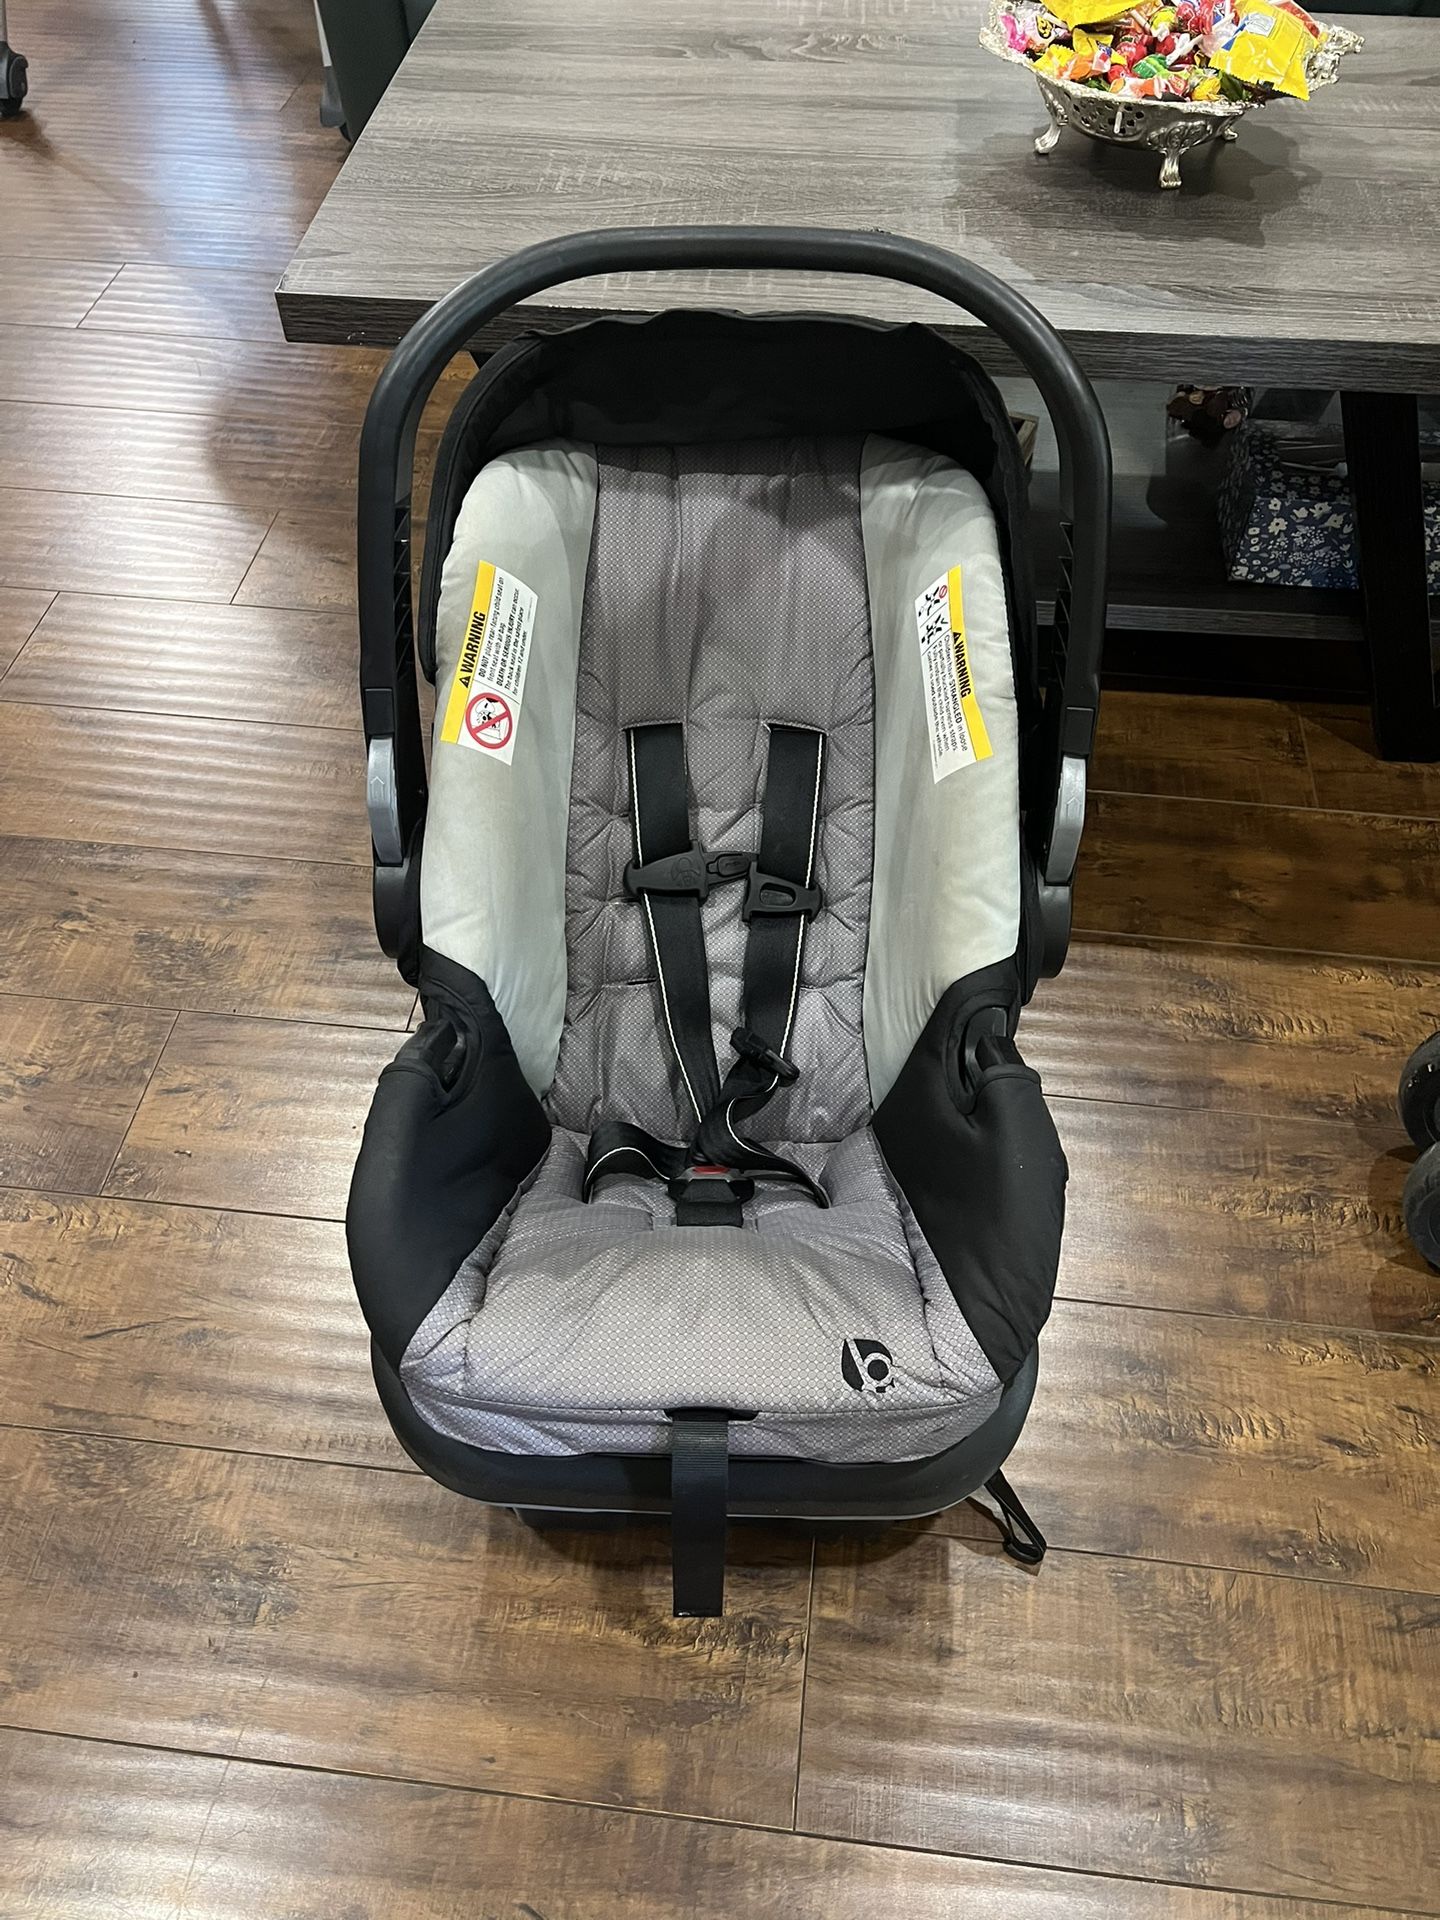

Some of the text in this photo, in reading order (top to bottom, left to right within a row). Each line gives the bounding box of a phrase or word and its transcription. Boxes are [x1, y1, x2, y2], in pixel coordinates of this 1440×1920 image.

[461, 611, 486, 673] WARNING
[481, 656, 489, 668] NOT
[497, 667, 506, 686] DEATH
[503, 635, 512, 658] SERIOUS
[944, 635, 952, 662] Children
[950, 679, 963, 723] STRANGLED
[955, 641, 971, 698] WARNING
[946, 701, 954, 728] harness
